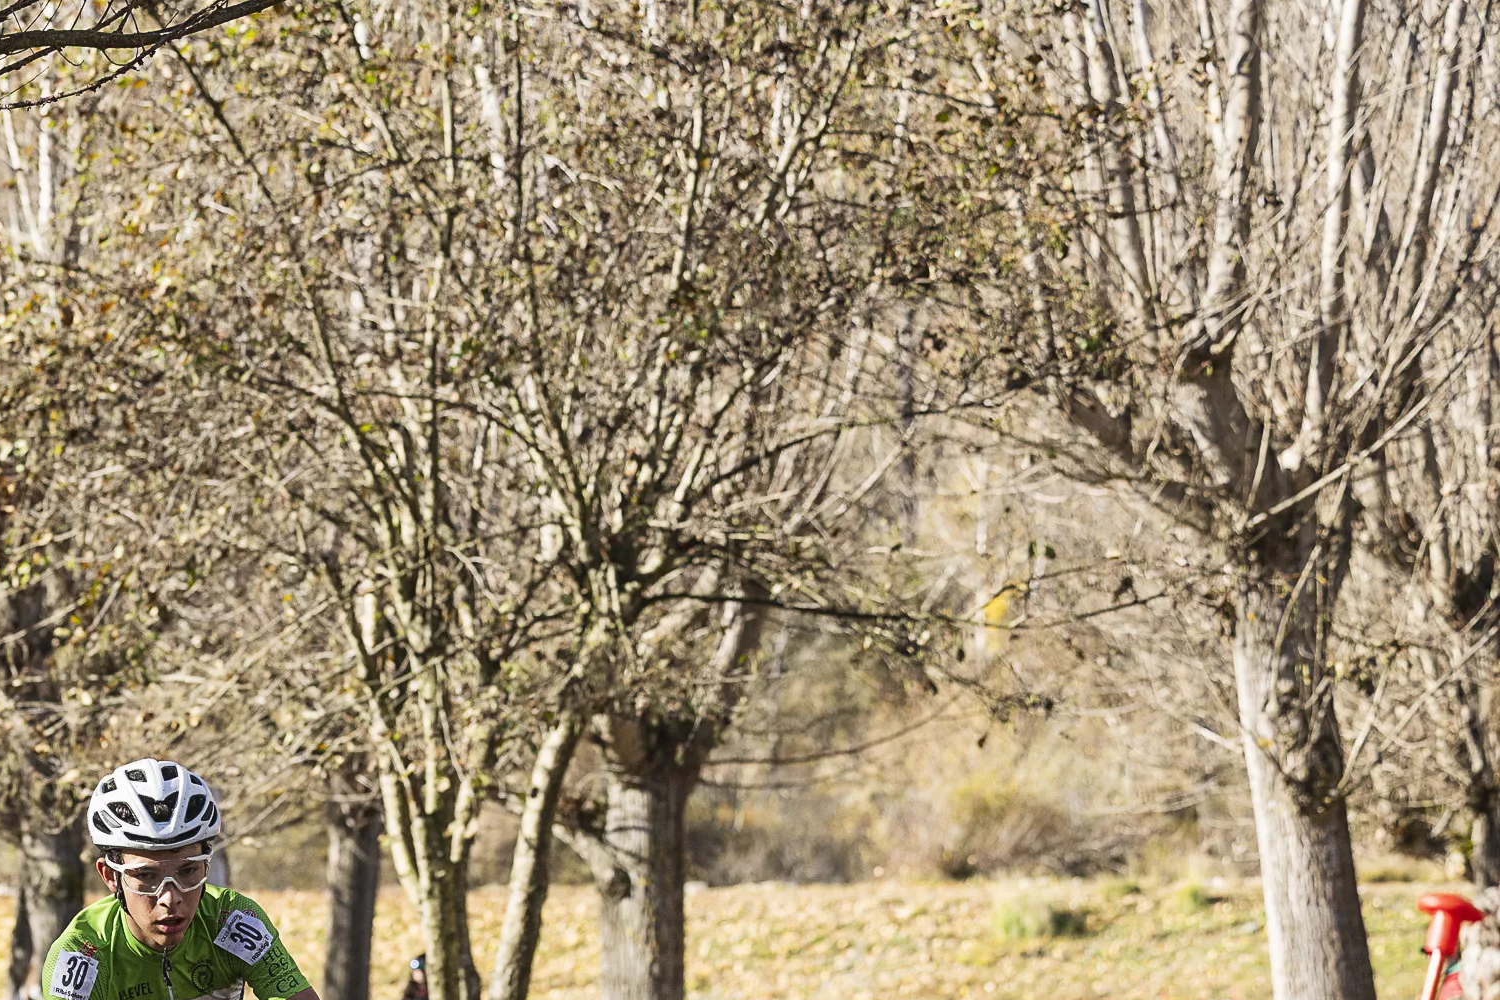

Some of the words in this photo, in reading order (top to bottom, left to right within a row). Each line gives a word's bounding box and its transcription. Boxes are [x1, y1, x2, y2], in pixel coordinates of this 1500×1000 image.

[229, 921, 263, 951] 30
[62, 956, 89, 990] 30
[276, 974, 299, 993] ca
